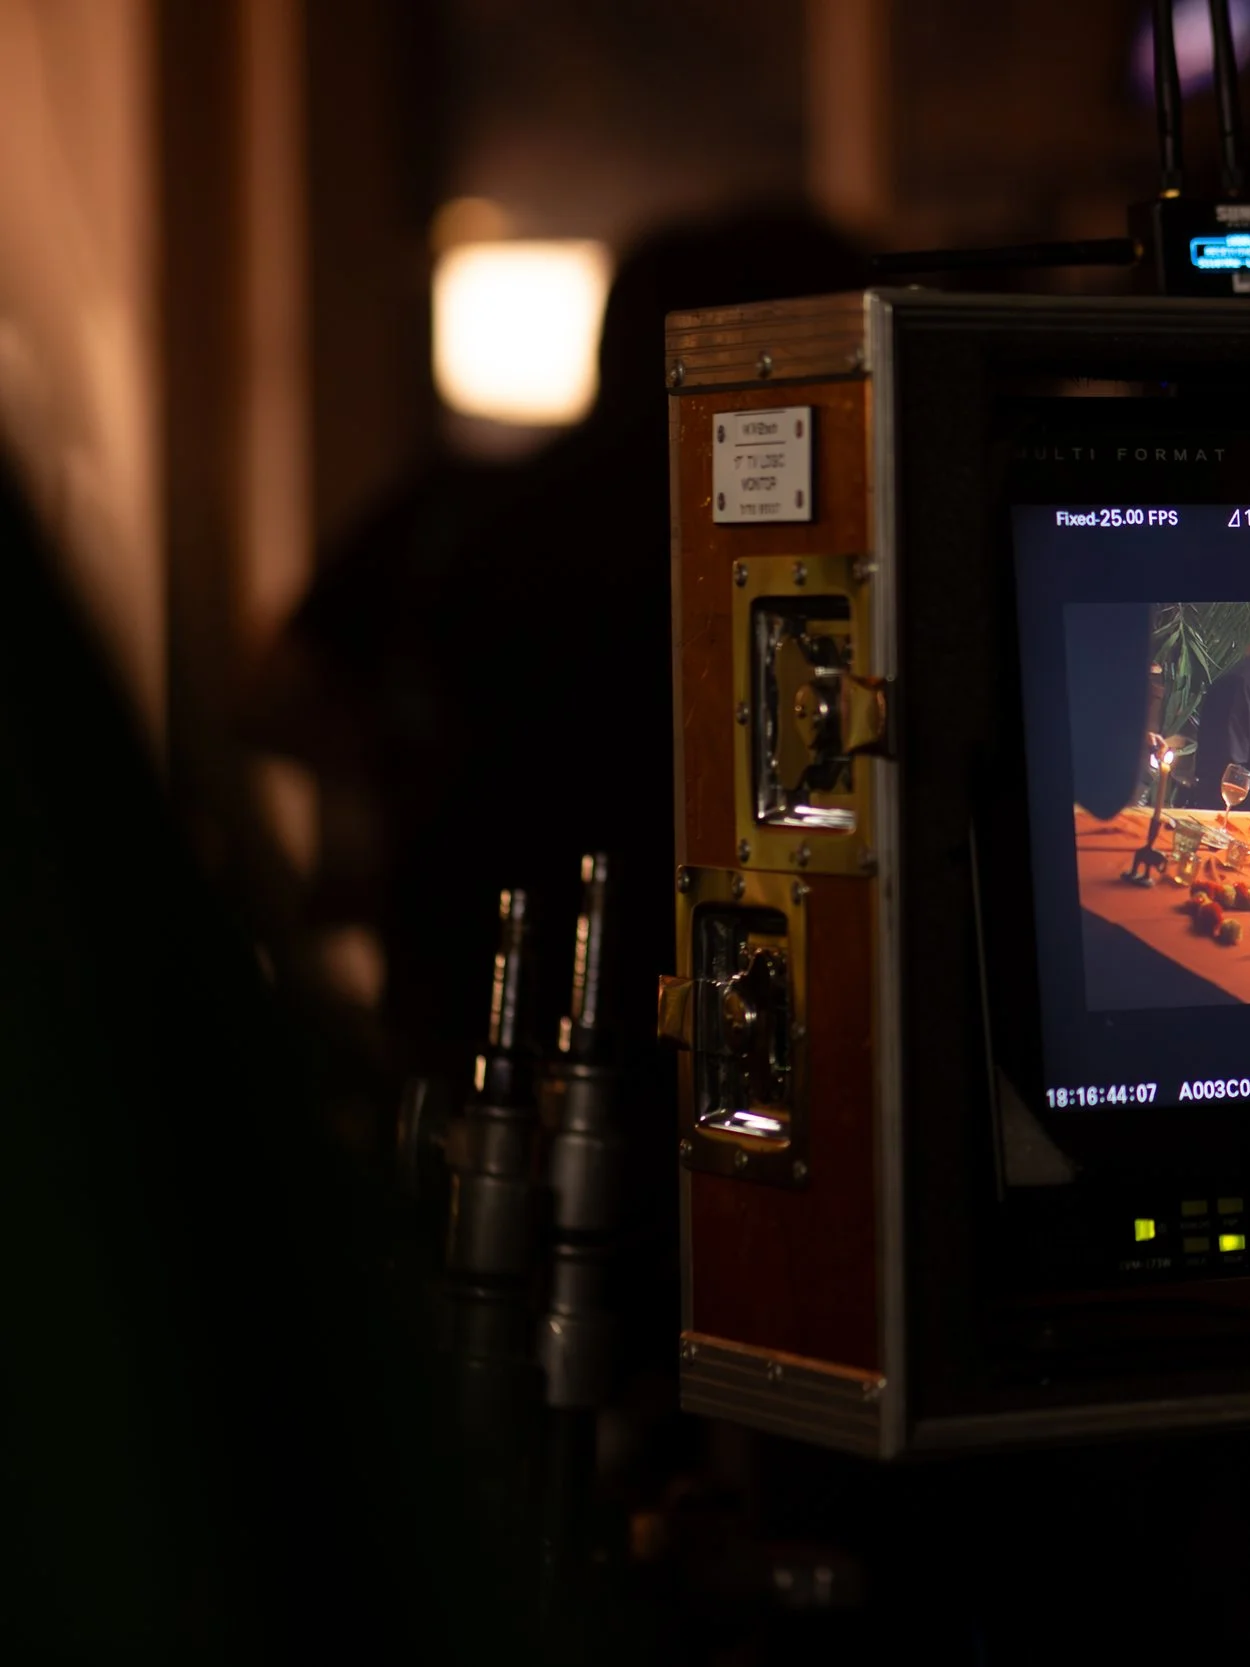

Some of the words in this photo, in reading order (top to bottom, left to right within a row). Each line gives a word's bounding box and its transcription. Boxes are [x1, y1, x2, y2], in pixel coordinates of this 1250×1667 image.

[1117, 447, 1225, 461] FORMAT
[1056, 508, 1144, 527] Fixed-25.00
[1148, 509, 1178, 527] FPS
[1046, 1083, 1158, 1109] 18:16:44:07
